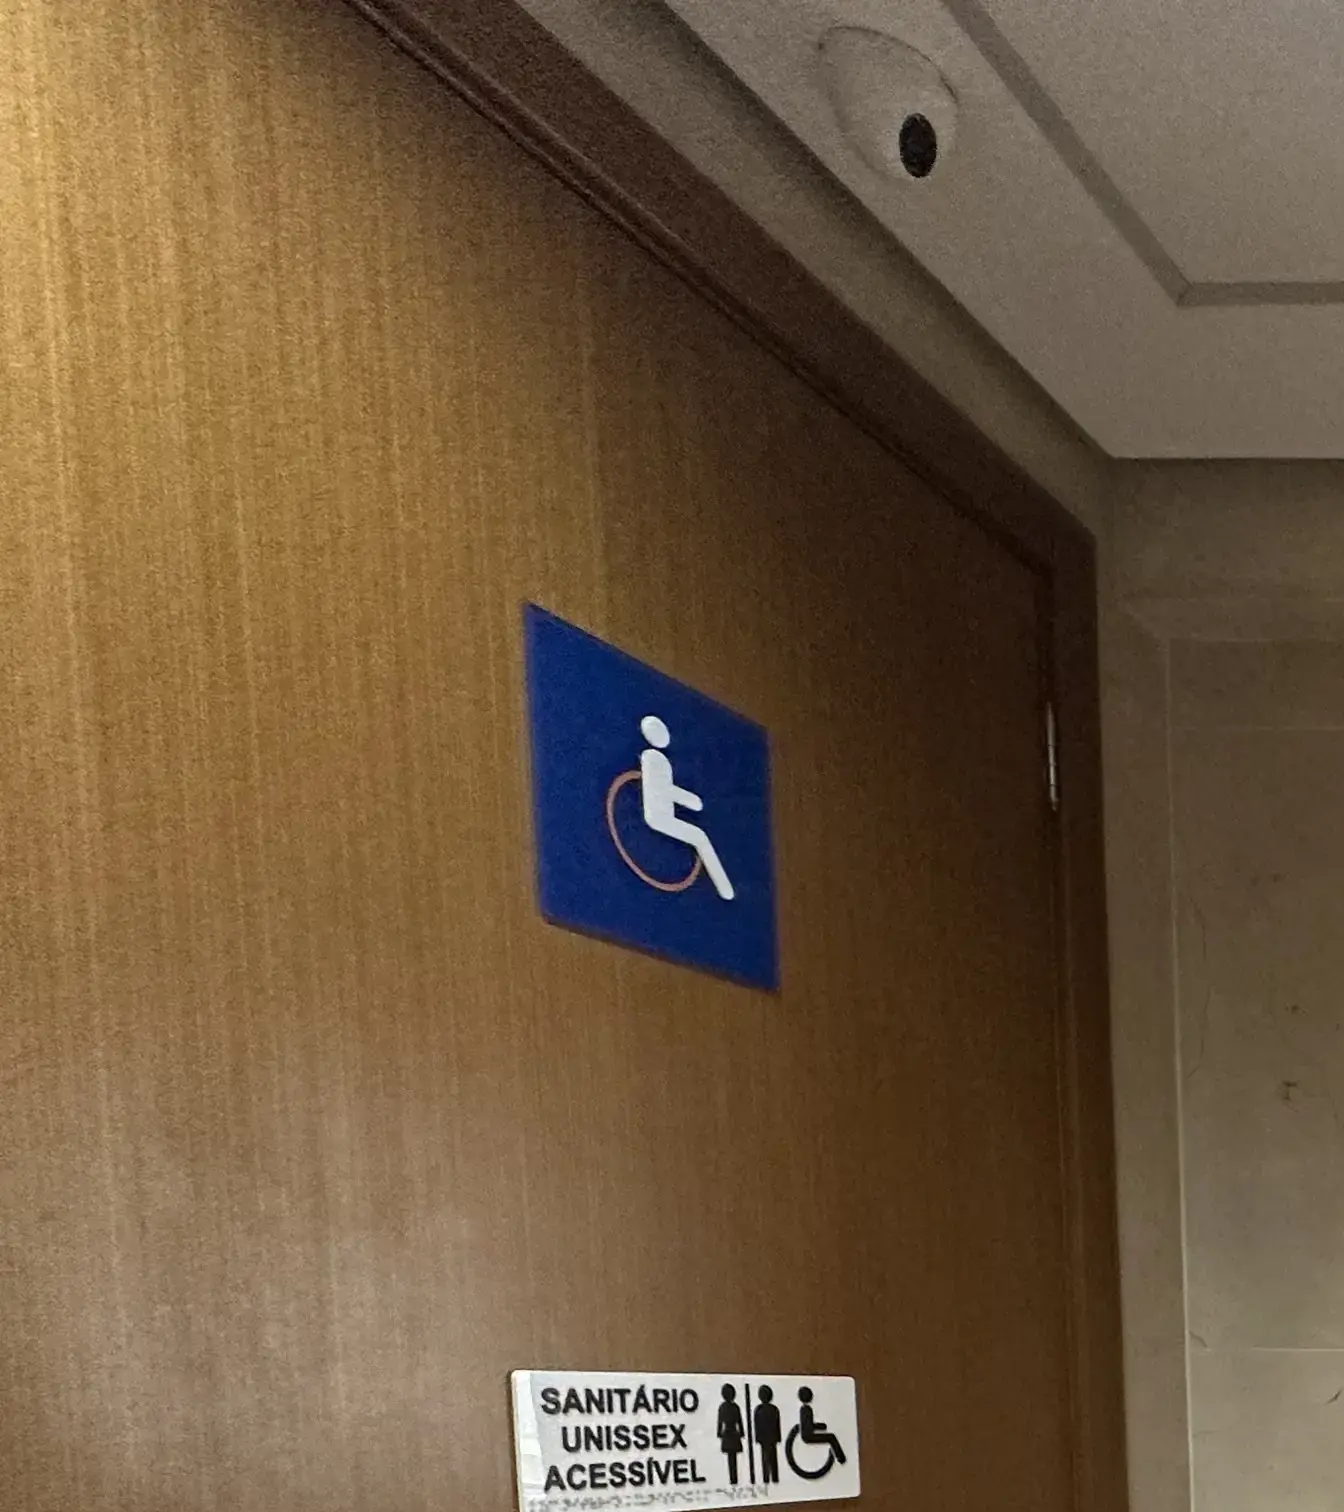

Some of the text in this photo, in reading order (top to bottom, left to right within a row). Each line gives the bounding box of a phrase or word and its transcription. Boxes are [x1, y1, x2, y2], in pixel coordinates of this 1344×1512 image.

[541, 1385, 700, 1415] SANITÁRIO
[561, 1423, 688, 1452] UNISSEX
[543, 1457, 706, 1493] ACESSÍVEL
